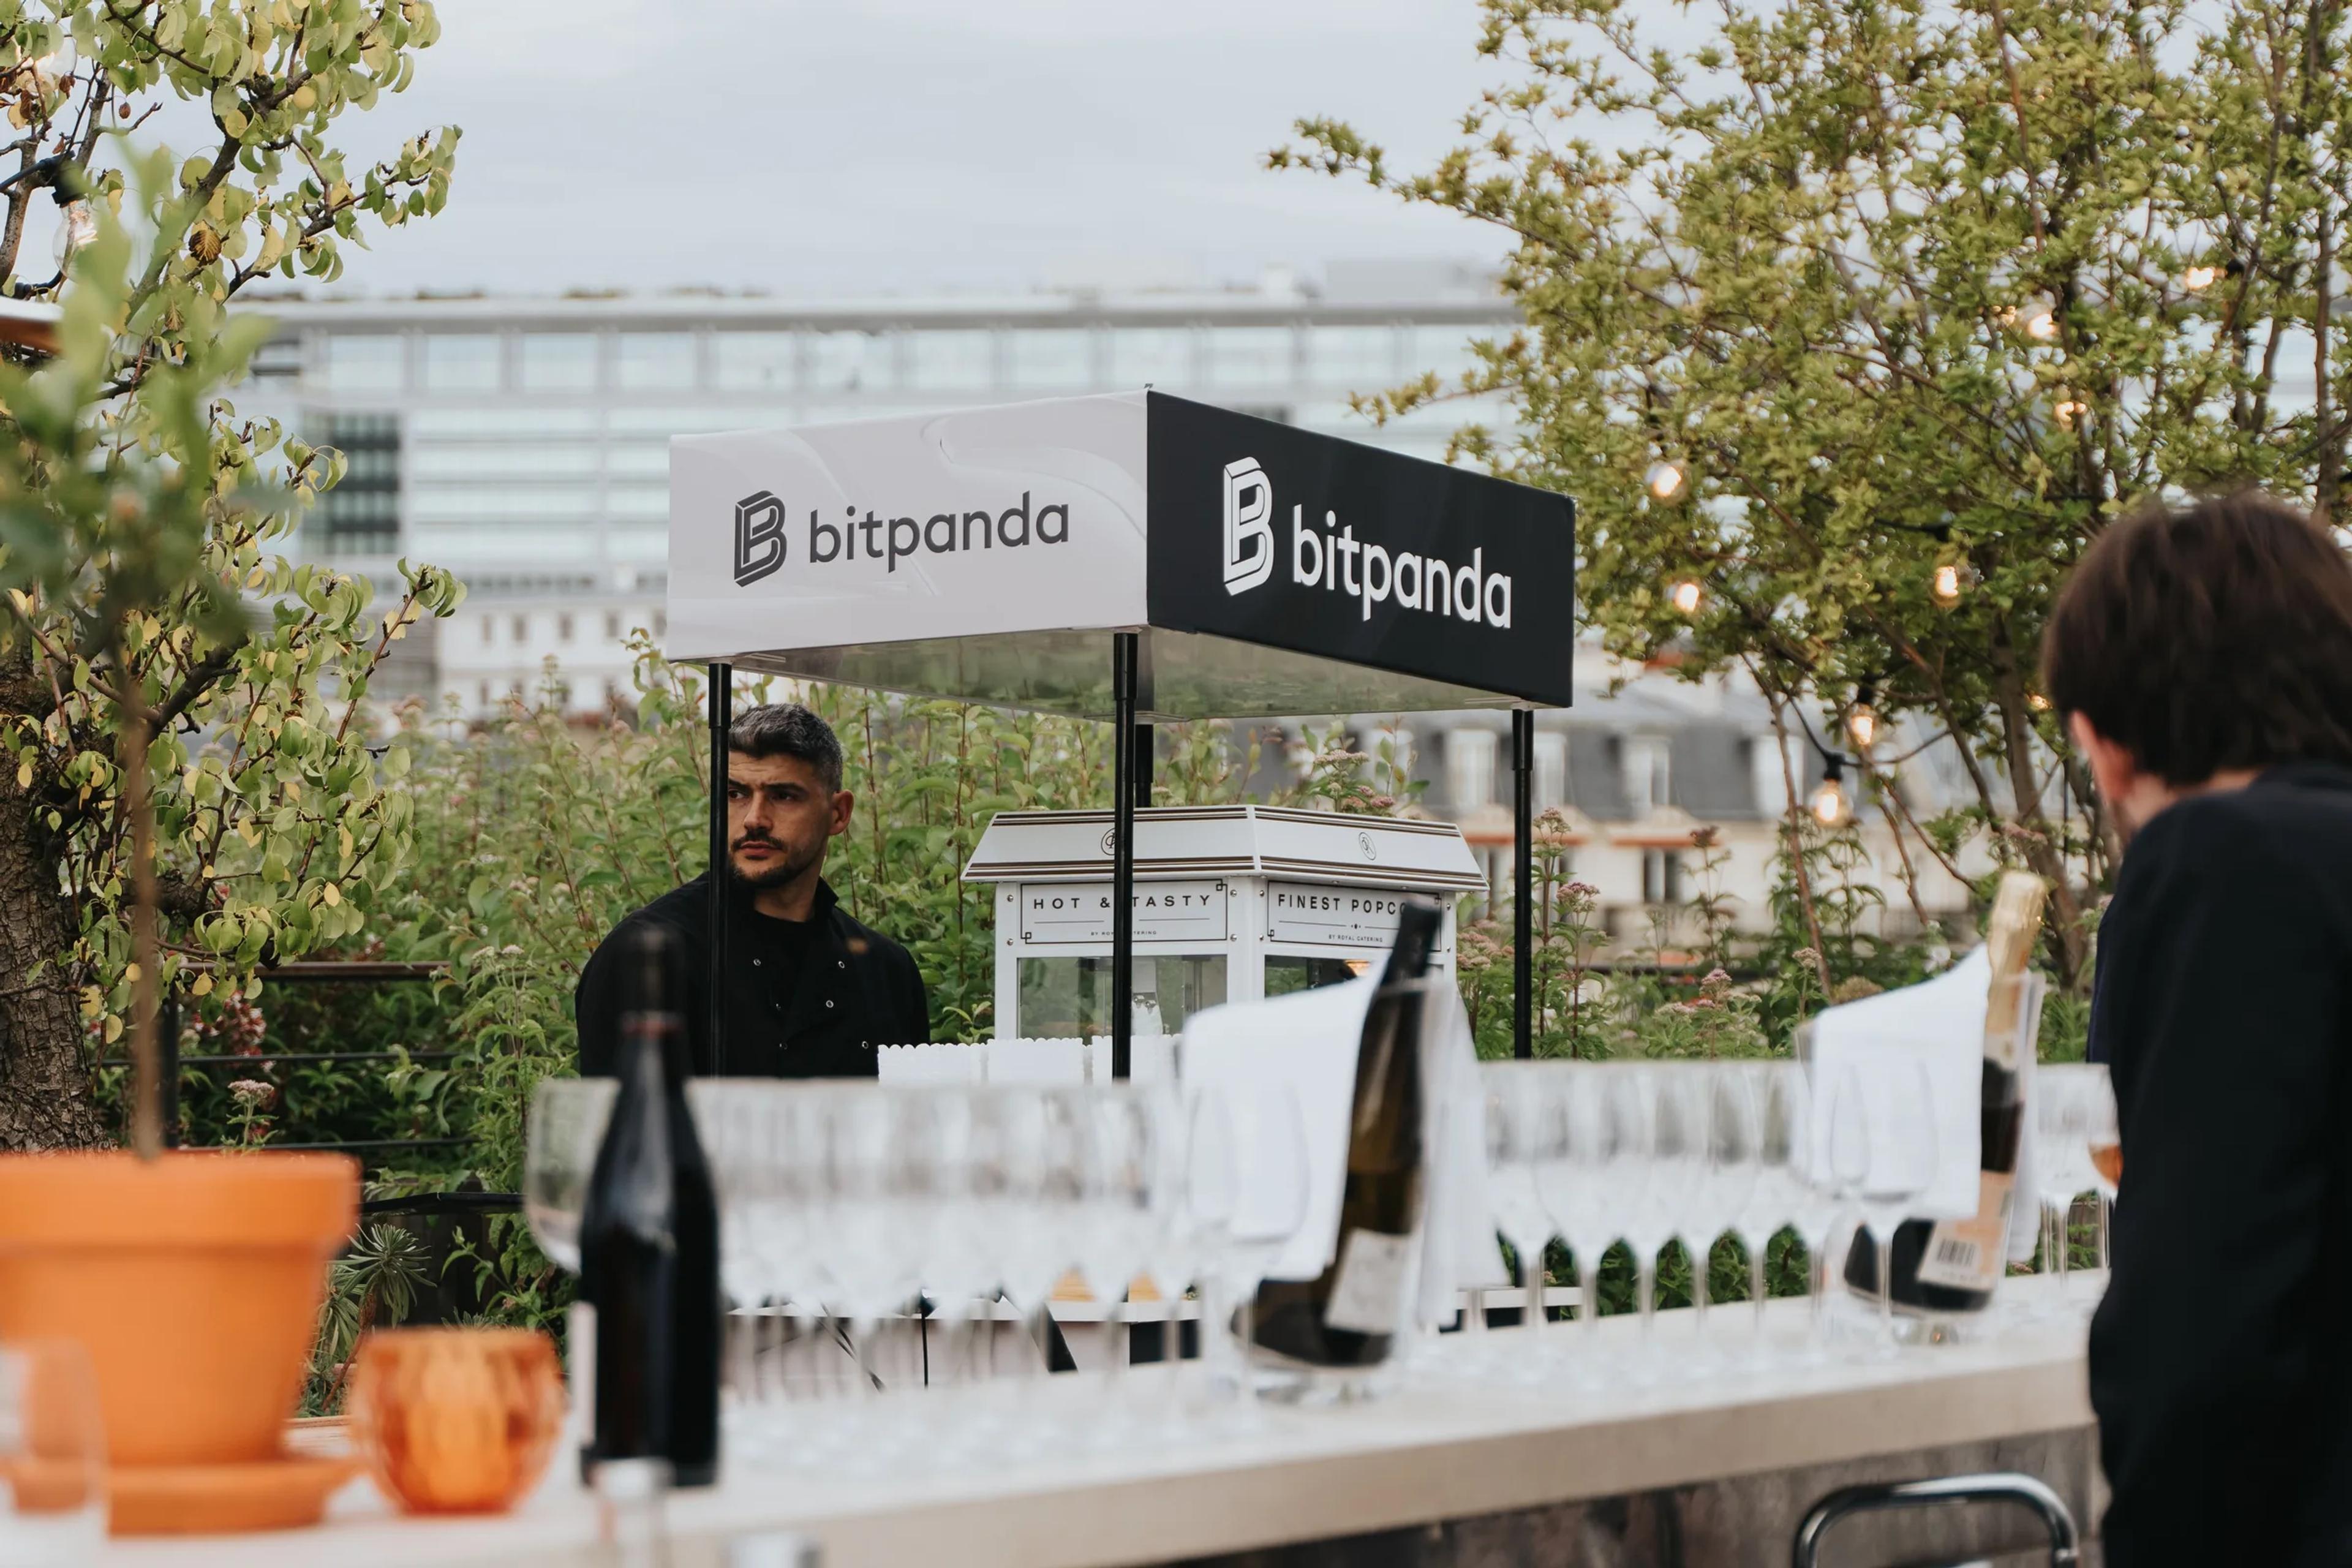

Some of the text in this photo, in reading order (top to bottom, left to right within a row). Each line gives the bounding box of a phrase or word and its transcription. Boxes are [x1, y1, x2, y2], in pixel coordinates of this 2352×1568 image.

[810, 490, 1069, 573] bitpanda
[1292, 503, 1512, 629] bitpanda
[1033, 895, 1209, 909] HOT & TASTY
[1278, 894, 1407, 914] FINEST POPCO
